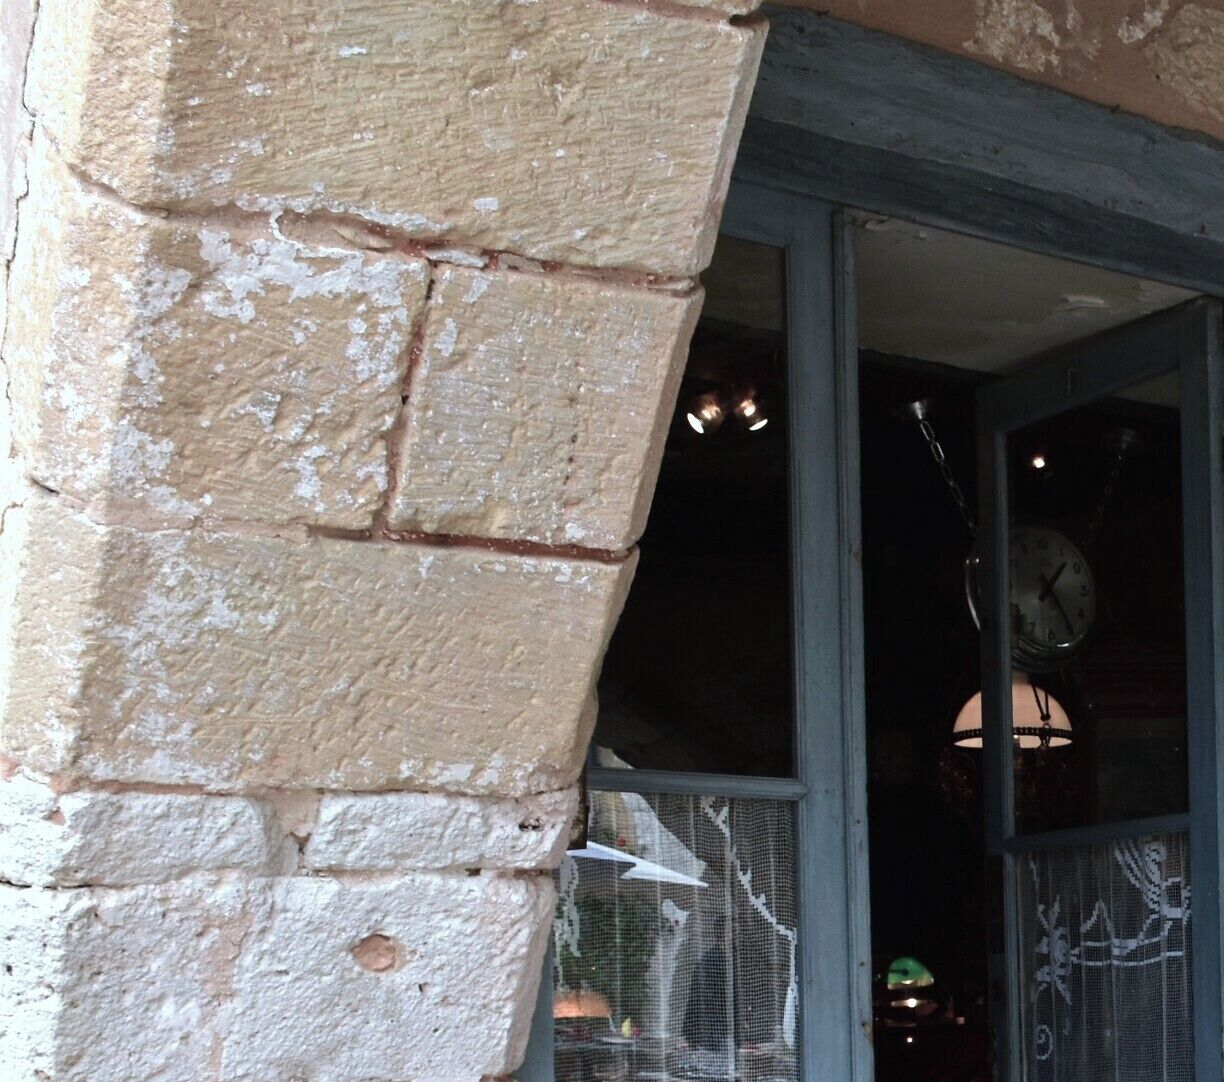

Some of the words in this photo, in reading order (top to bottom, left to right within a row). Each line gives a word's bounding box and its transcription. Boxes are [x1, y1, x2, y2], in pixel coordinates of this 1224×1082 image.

[1073, 562, 1081, 574] 2
[1080, 585, 1088, 597] 3
[1029, 622, 1035, 634] 7
[1048, 629, 1056, 640] 6
